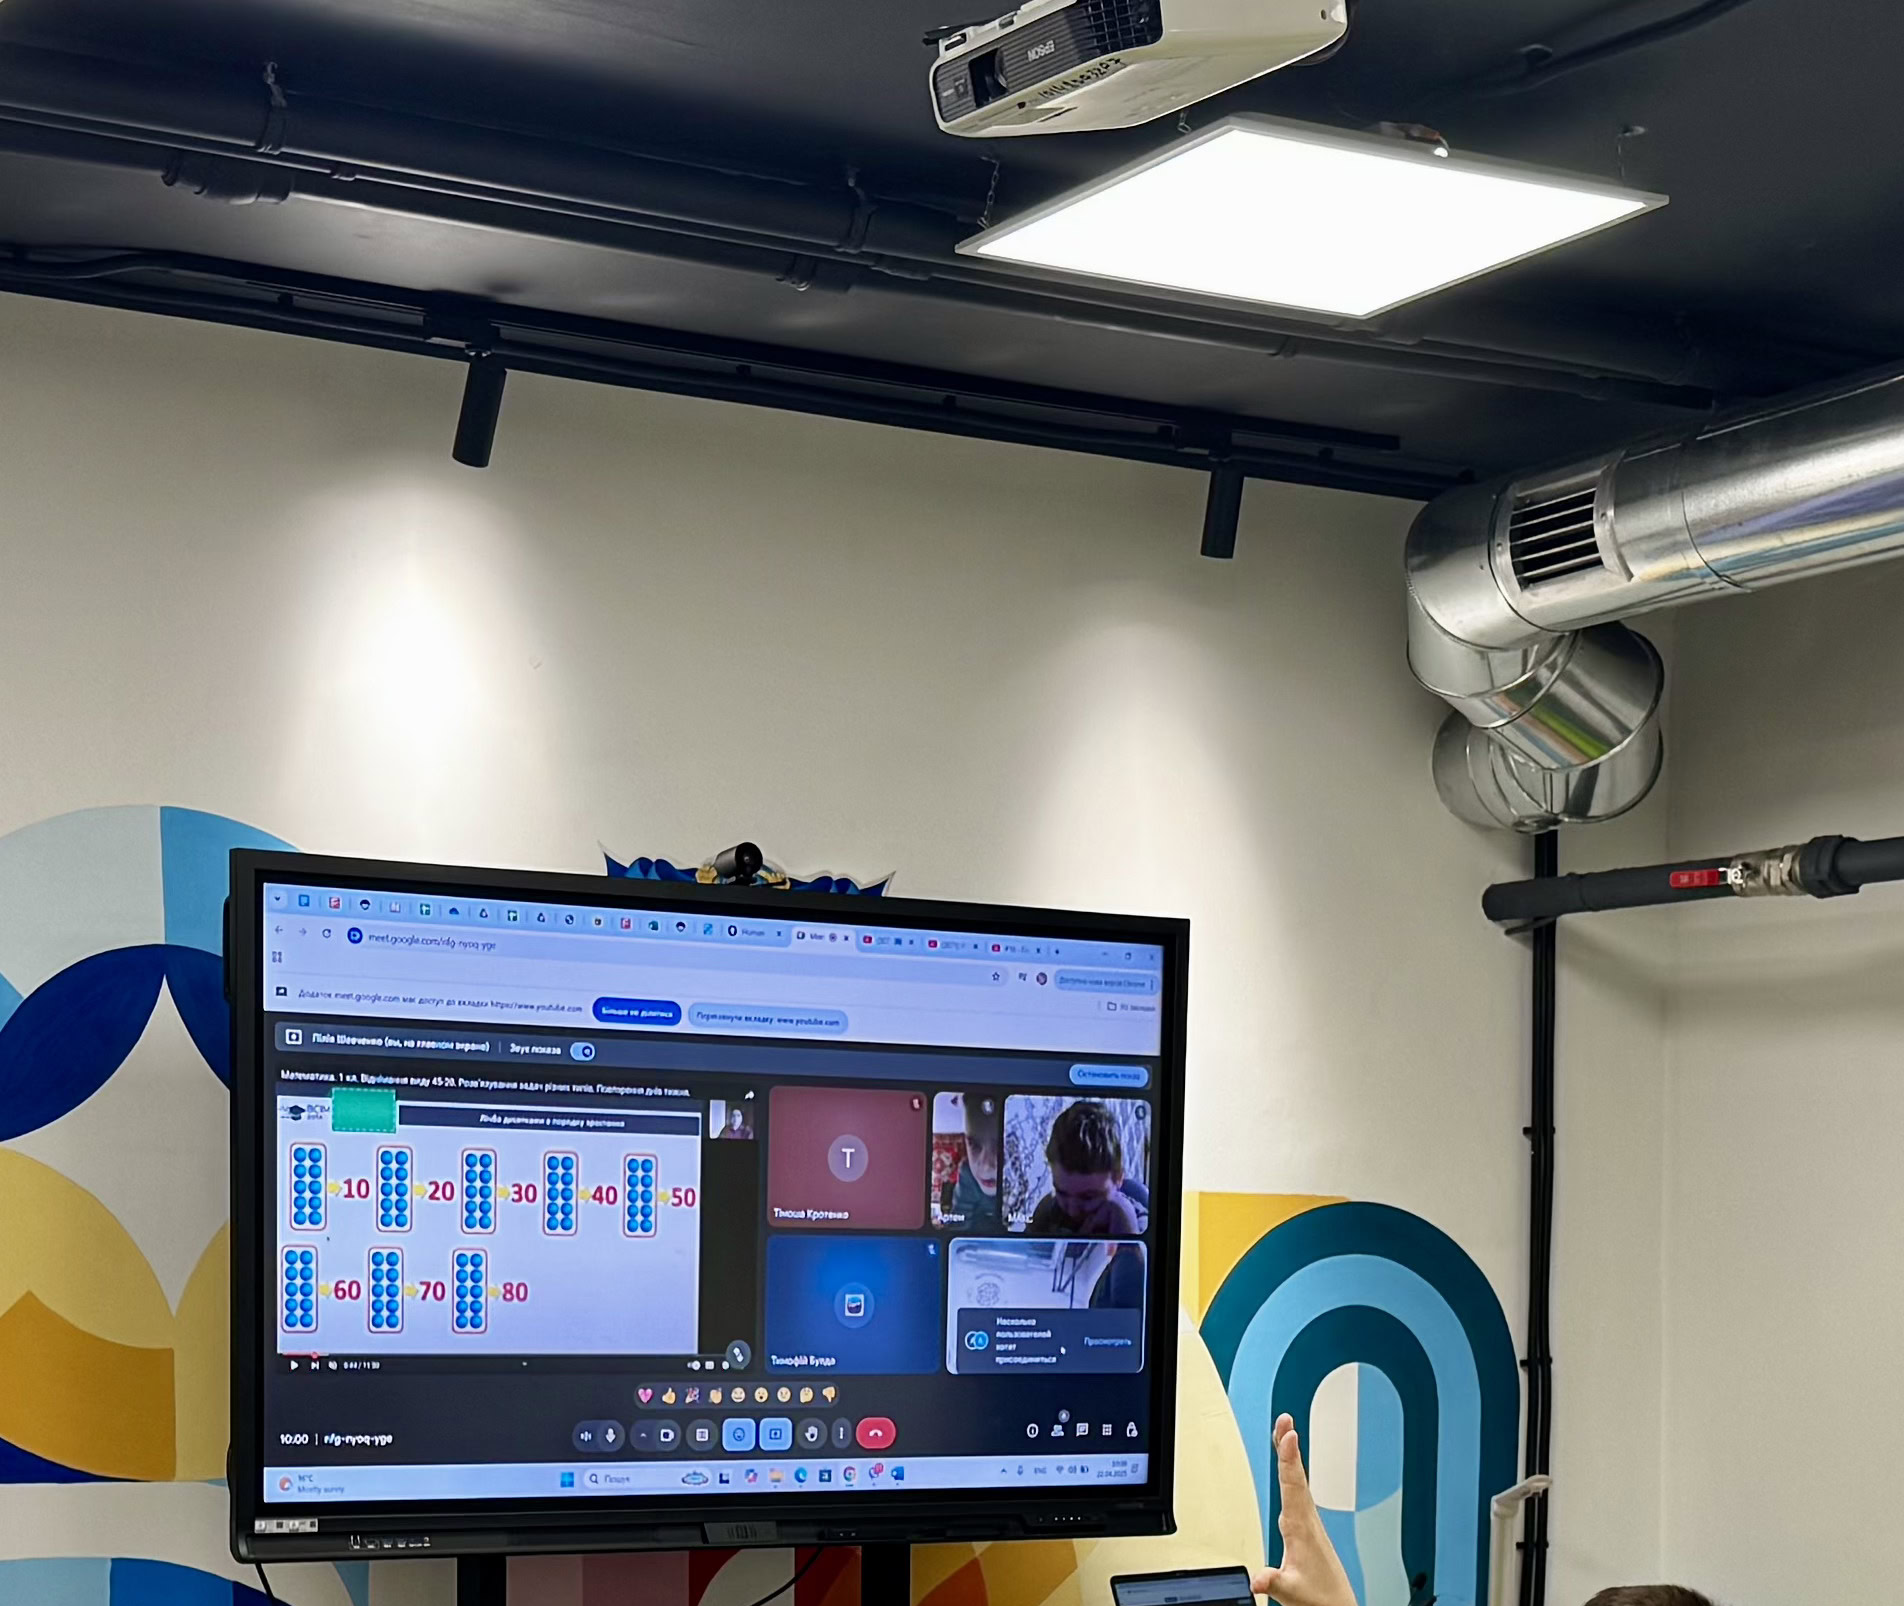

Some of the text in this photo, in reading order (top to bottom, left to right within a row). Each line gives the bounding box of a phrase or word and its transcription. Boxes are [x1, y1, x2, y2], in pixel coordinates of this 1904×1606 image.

[1027, 40, 1056, 62] EPSON
[343, 1178, 370, 1199] 10
[428, 1181, 455, 1201] 20
[511, 1183, 537, 1203] 30
[592, 1186, 618, 1205] 40
[671, 1187, 696, 1207] 50
[333, 1280, 362, 1301] 60
[419, 1280, 446, 1301] 70
[502, 1282, 528, 1302] 80
